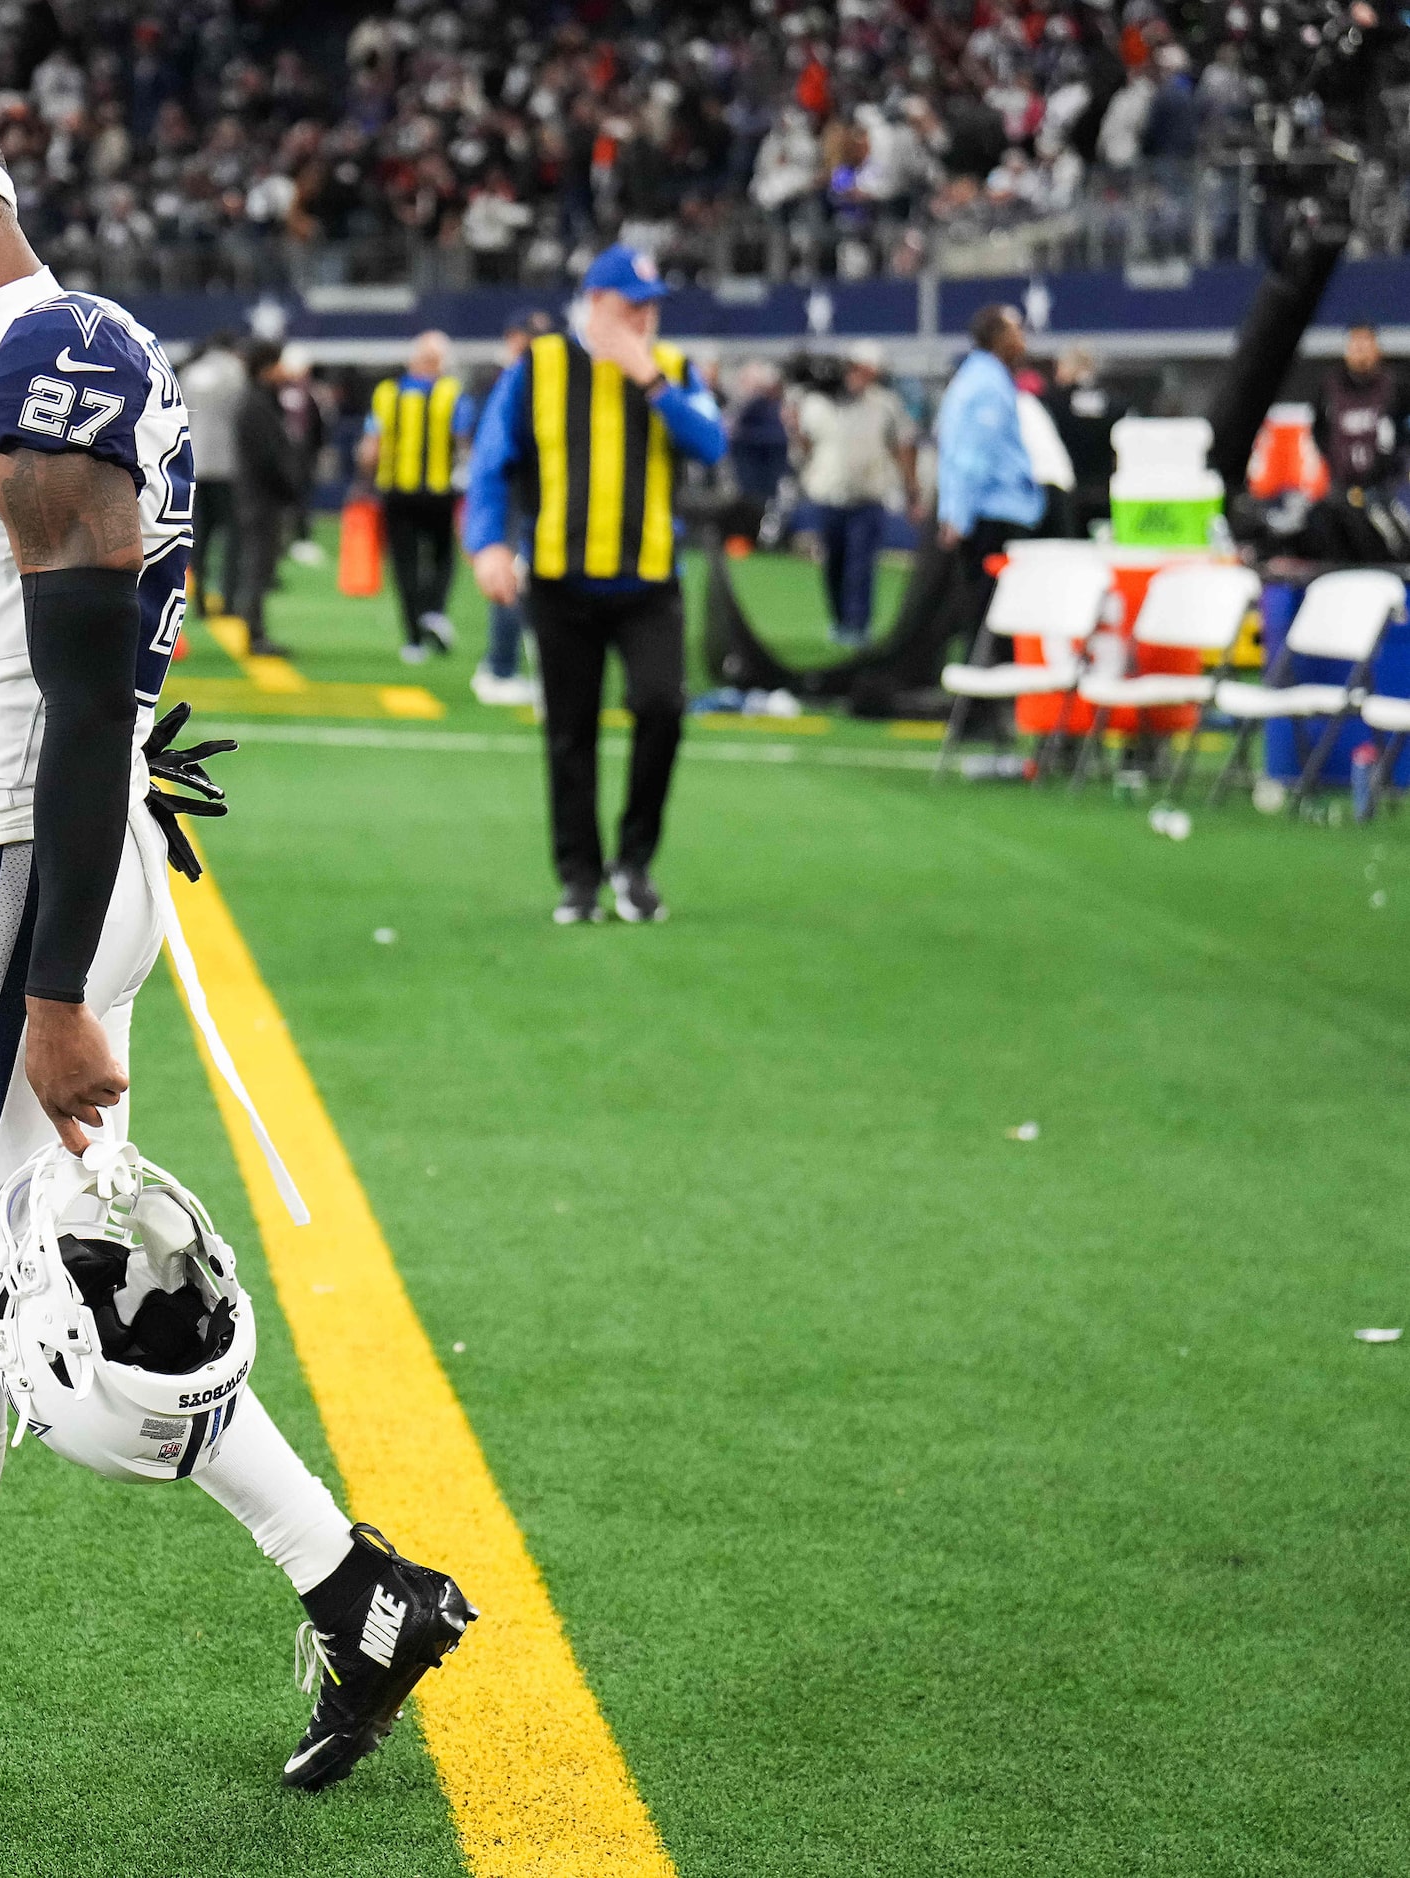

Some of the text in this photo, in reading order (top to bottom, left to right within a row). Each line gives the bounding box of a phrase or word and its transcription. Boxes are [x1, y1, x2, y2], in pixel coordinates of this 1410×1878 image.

[17, 374, 126, 447] 27
[178, 1360, 248, 1409] COWBOYS
[359, 1583, 408, 1669] NIKE
